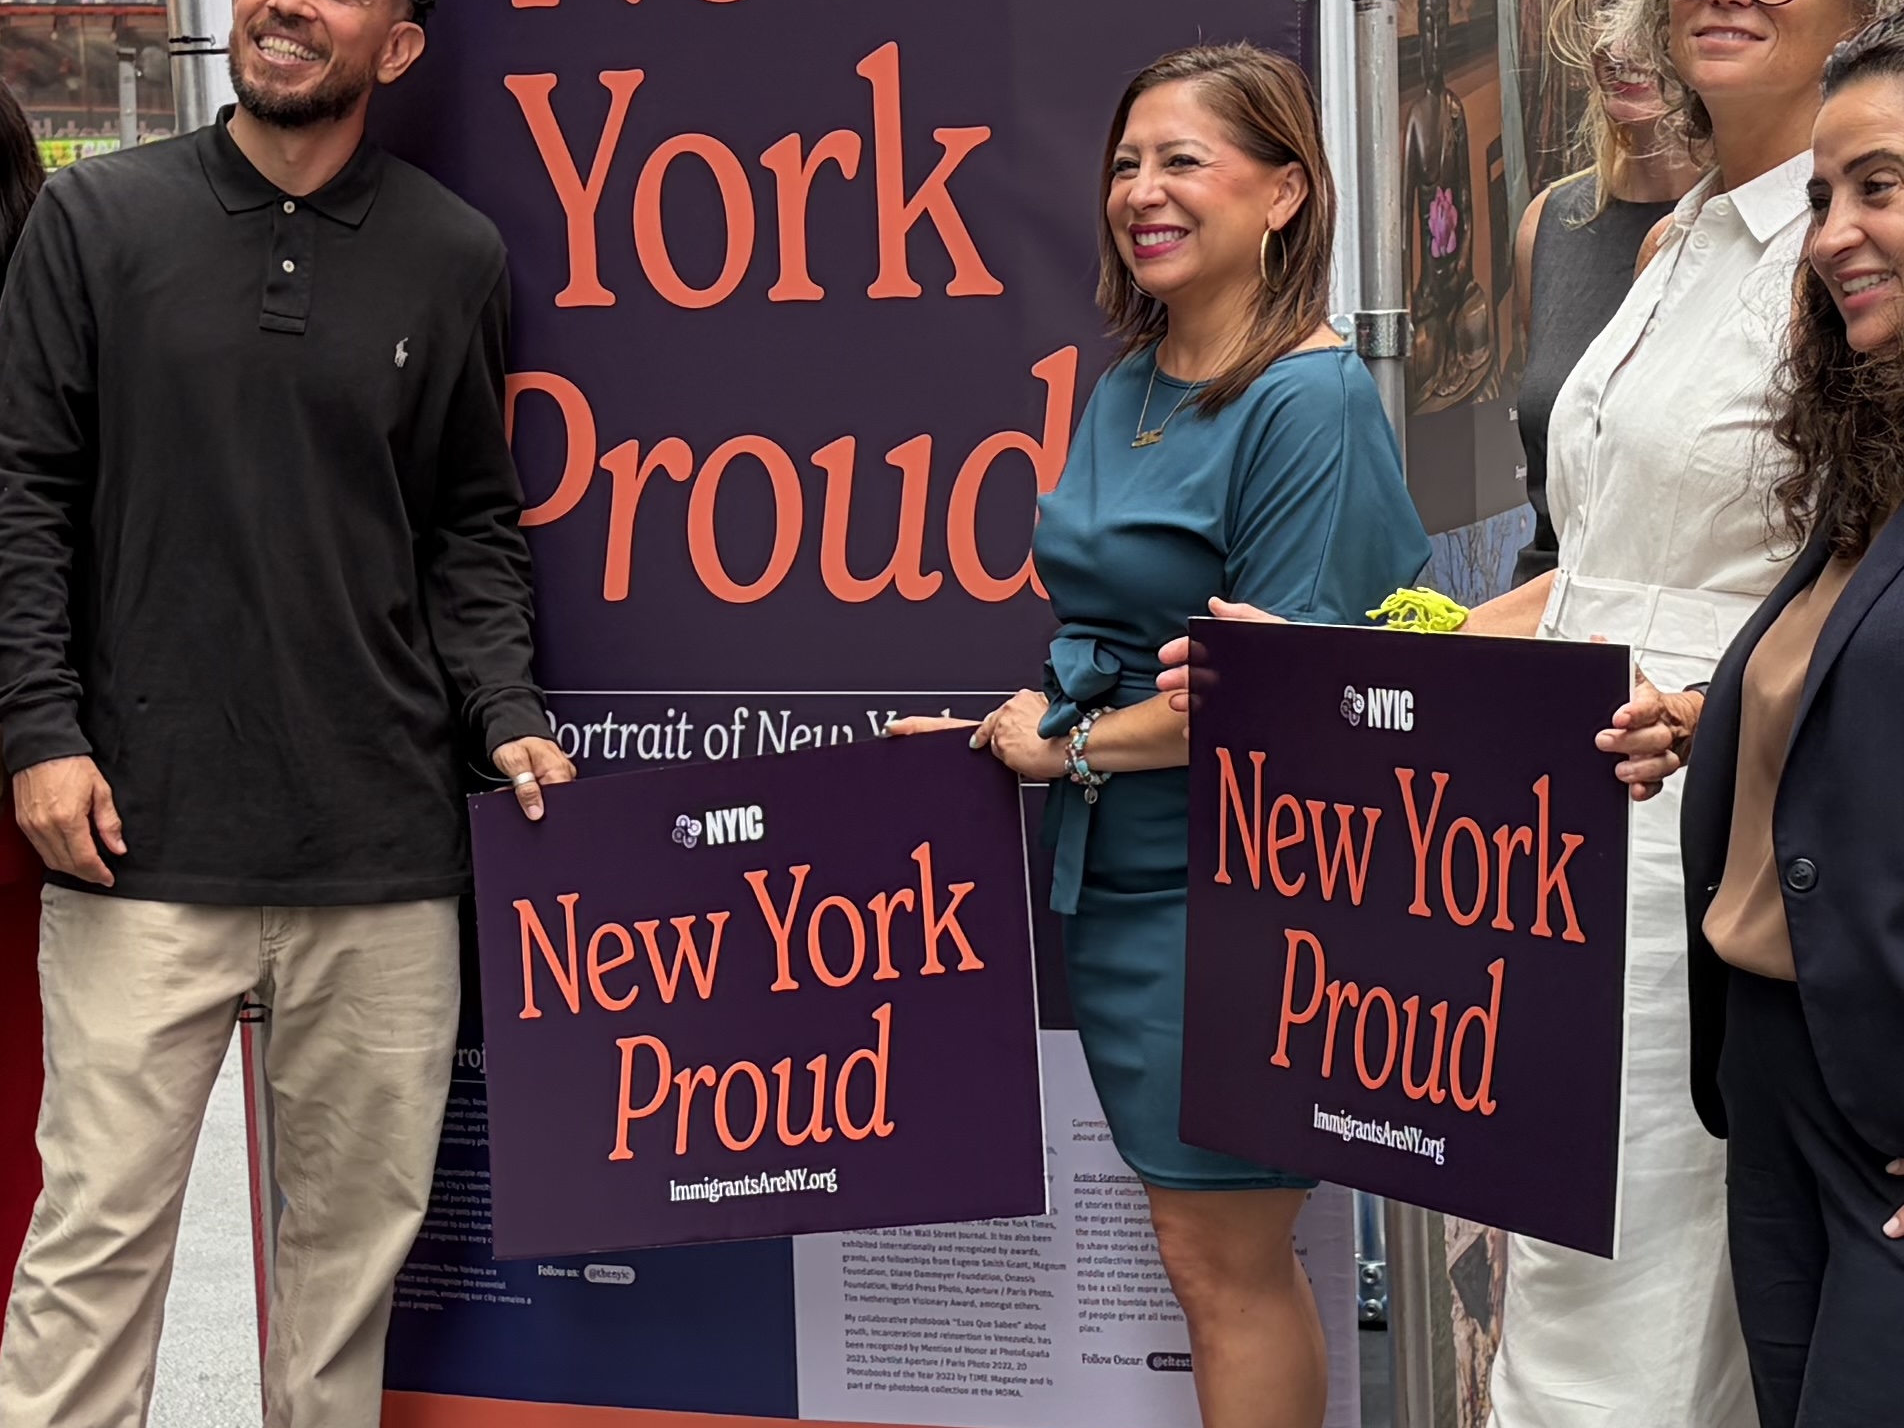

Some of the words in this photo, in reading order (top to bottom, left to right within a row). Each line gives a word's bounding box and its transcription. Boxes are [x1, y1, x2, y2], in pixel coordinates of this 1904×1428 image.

[503, 40, 1005, 309] York
[504, 344, 1080, 604] Proud
[545, 708, 698, 762] ortrait
[704, 706, 749, 759] of
[1367, 685, 1415, 733] NYIC
[705, 804, 765, 846] NYIC
[1213, 747, 1382, 907] New
[1395, 766, 1587, 944] York
[512, 891, 731, 1019] New
[743, 841, 985, 993] York
[1269, 928, 1505, 1117] Proud
[607, 1002, 896, 1162] Proud
[1312, 1103, 1447, 1166] ImmigrantsAreNY.org
[670, 1168, 839, 1203] ImmigrantsAreNY.org
[1073, 1173, 1096, 1183] Artist
[537, 1264, 566, 1278] Follow
[1081, 1352, 1110, 1365] Follow
[1113, 1354, 1143, 1366] Oscar:
